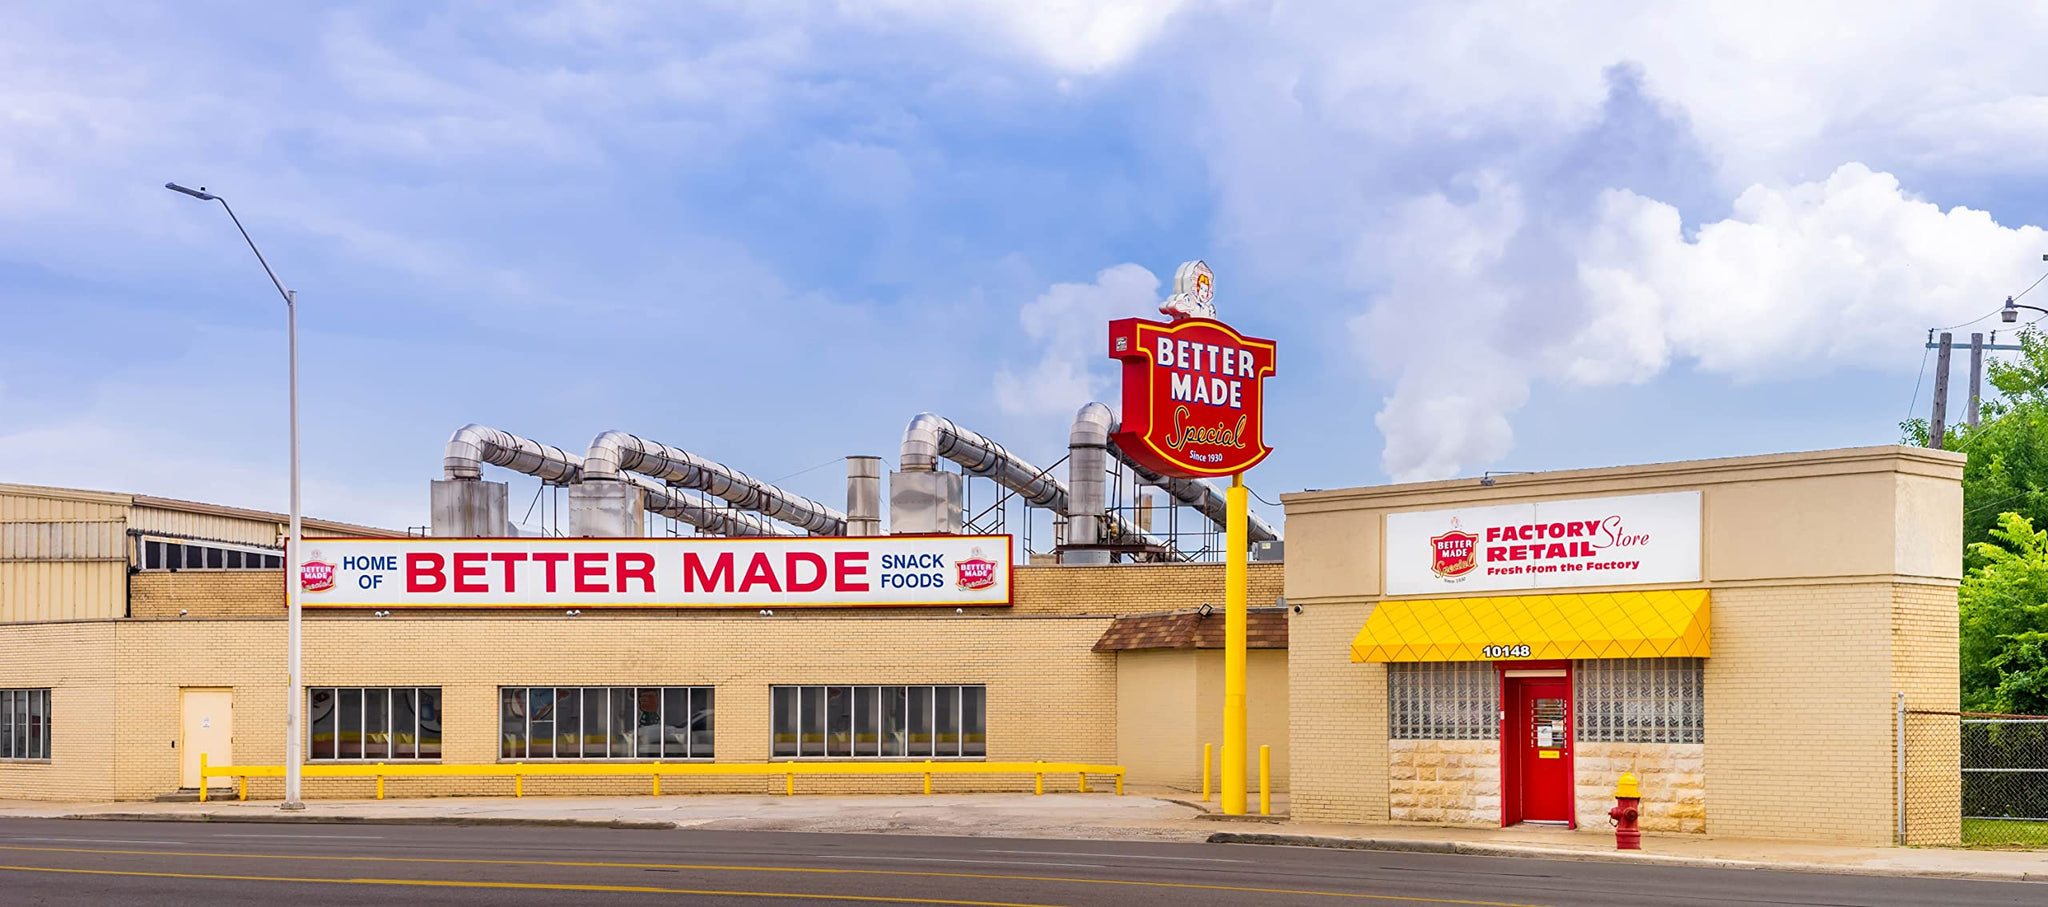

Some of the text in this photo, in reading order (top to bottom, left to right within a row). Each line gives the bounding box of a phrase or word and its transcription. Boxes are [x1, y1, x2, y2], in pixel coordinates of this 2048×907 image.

[1157, 336, 1255, 379] BETTER
[1170, 371, 1242, 409] MADE
[1166, 405, 1247, 452] Special
[1189, 450, 1223, 462] Since 1930
[1487, 520, 1602, 543] FACTORY
[1593, 515, 1650, 549] Store
[1437, 540, 1472, 550] BETTER
[1442, 548, 1467, 558] MADE
[1487, 541, 1596, 562] RETAIL
[343, 556, 397, 570] HOME
[881, 553, 944, 569] SNACK
[1487, 560, 1640, 576] Fresh from the Factory
[406, 551, 869, 593] BETTER MADE
[358, 574, 383, 589] OF
[881, 573, 944, 589] FOODS
[1482, 645, 1531, 658] 10148
